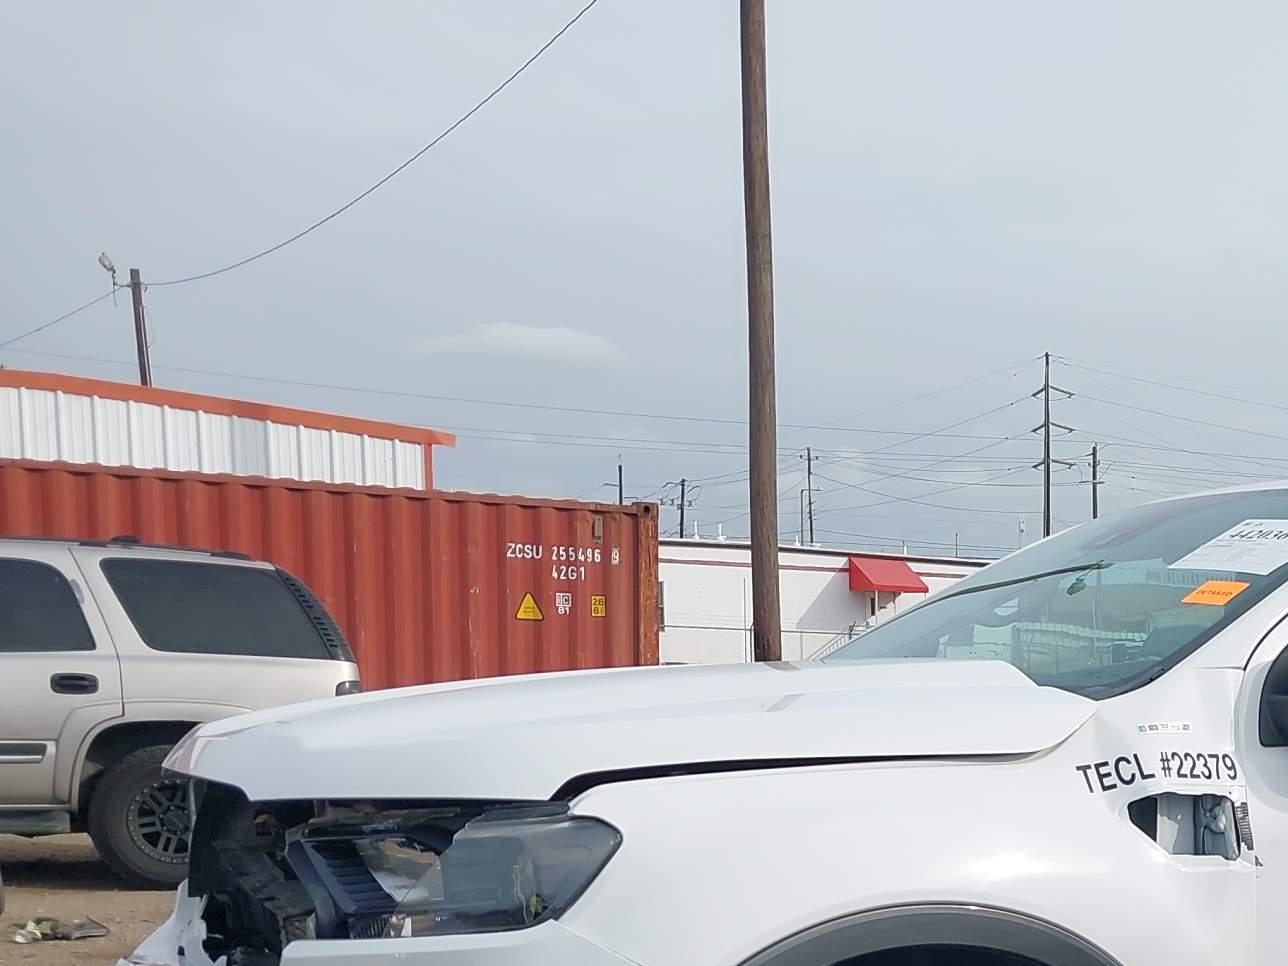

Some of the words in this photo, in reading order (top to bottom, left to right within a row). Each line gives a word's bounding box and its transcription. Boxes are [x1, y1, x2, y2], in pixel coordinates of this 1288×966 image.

[506, 543, 543, 559] ZCSU
[551, 546, 601, 562] 255496
[552, 564, 585, 580] 42G1
[1075, 753, 1156, 793] TECL
[1160, 751, 1238, 780] #22379
